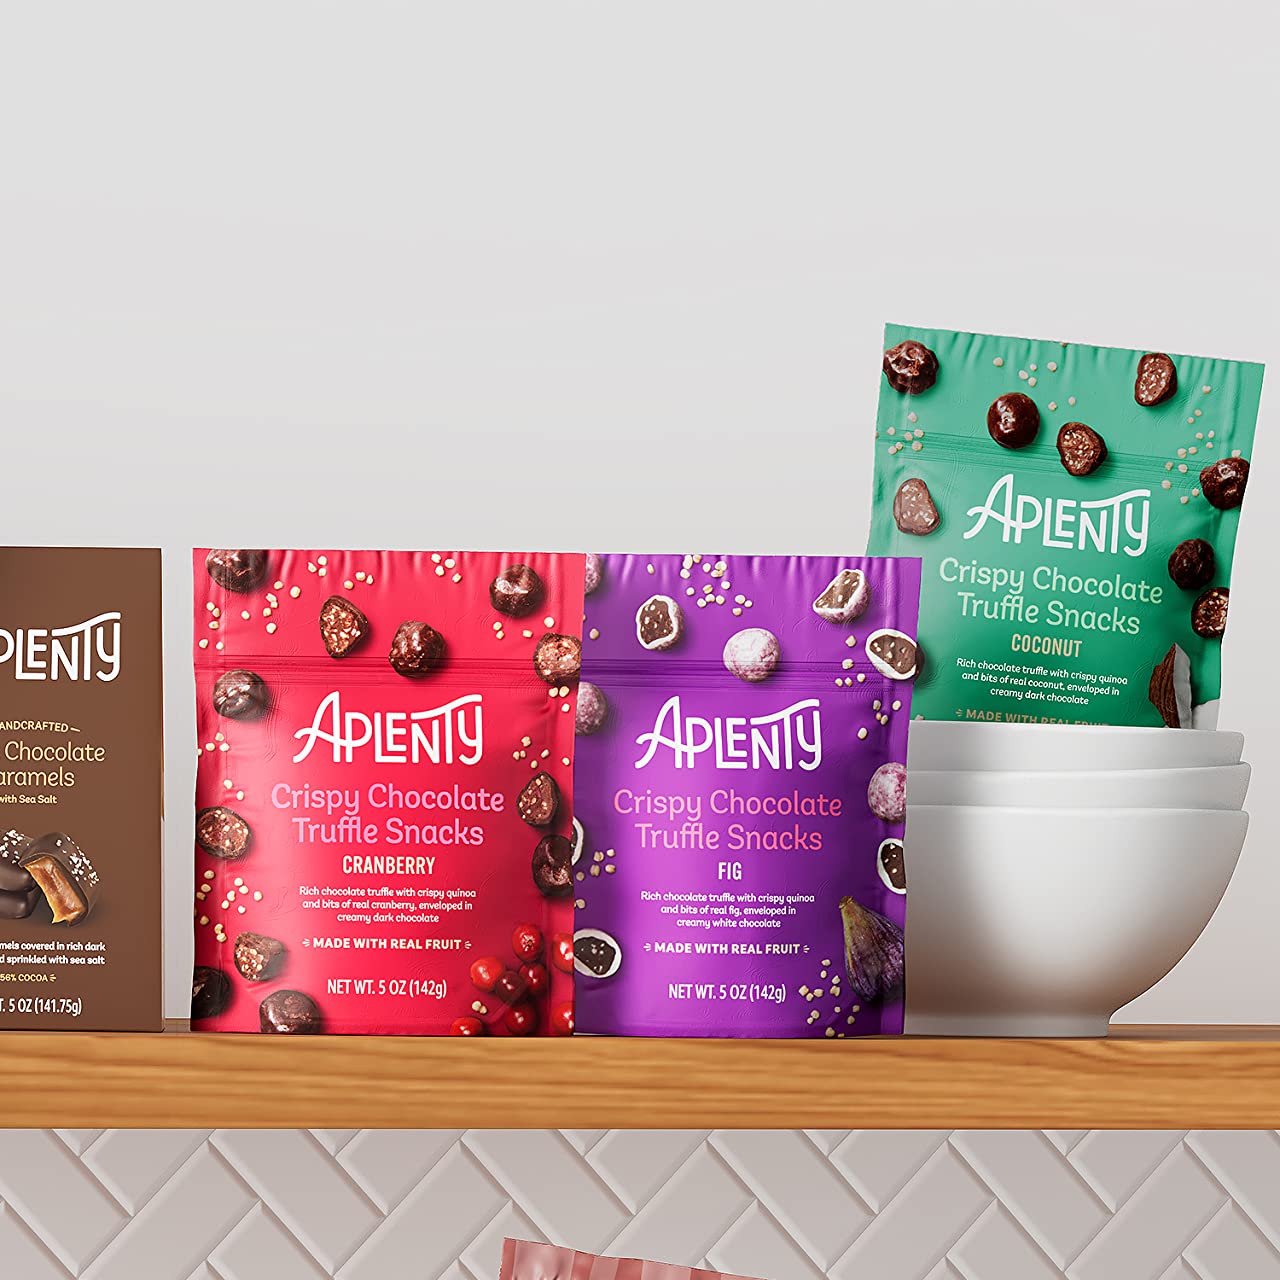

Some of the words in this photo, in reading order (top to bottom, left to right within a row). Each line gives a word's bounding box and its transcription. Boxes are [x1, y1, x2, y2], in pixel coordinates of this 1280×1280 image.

[963, 473, 1151, 557] APLENTY
[939, 557, 1024, 592] Crispy
[1033, 567, 1162, 603] Chocolate
[957, 591, 1040, 624] Truffle
[1046, 601, 1139, 634] Snacks
[1012, 634, 1082, 657] COCONUT
[990, 688, 1023, 700] creamy
[1025, 690, 1045, 700] dark
[1047, 693, 1089, 704] chocolate
[293, 691, 482, 765] APLENTY
[635, 696, 822, 770] APLENTY
[5, 741, 104, 761] Chocolate
[19, 795, 37, 804] Sea
[38, 795, 57, 803] Salt
[271, 783, 360, 816] Crispy
[369, 783, 504, 811] Chocolate
[614, 789, 701, 821] Crispy
[711, 789, 841, 816] Chocolate
[292, 817, 378, 844] Truffle
[386, 818, 483, 845] Snacks
[635, 823, 720, 849] Truffle
[728, 824, 821, 850] Snacks
[343, 856, 435, 874] CRANBERRY
[719, 862, 741, 880] FIG
[300, 887, 319, 896] Rich
[322, 887, 365, 896] chocolate
[367, 887, 394, 896] truffle
[396, 888, 415, 896] with
[418, 890, 444, 899] crispy
[447, 888, 476, 899] quinoa
[655, 942, 691, 953] MADE
[695, 943, 729, 954] WITH
[732, 944, 762, 954] REAL
[766, 944, 800, 954] FRUIT
